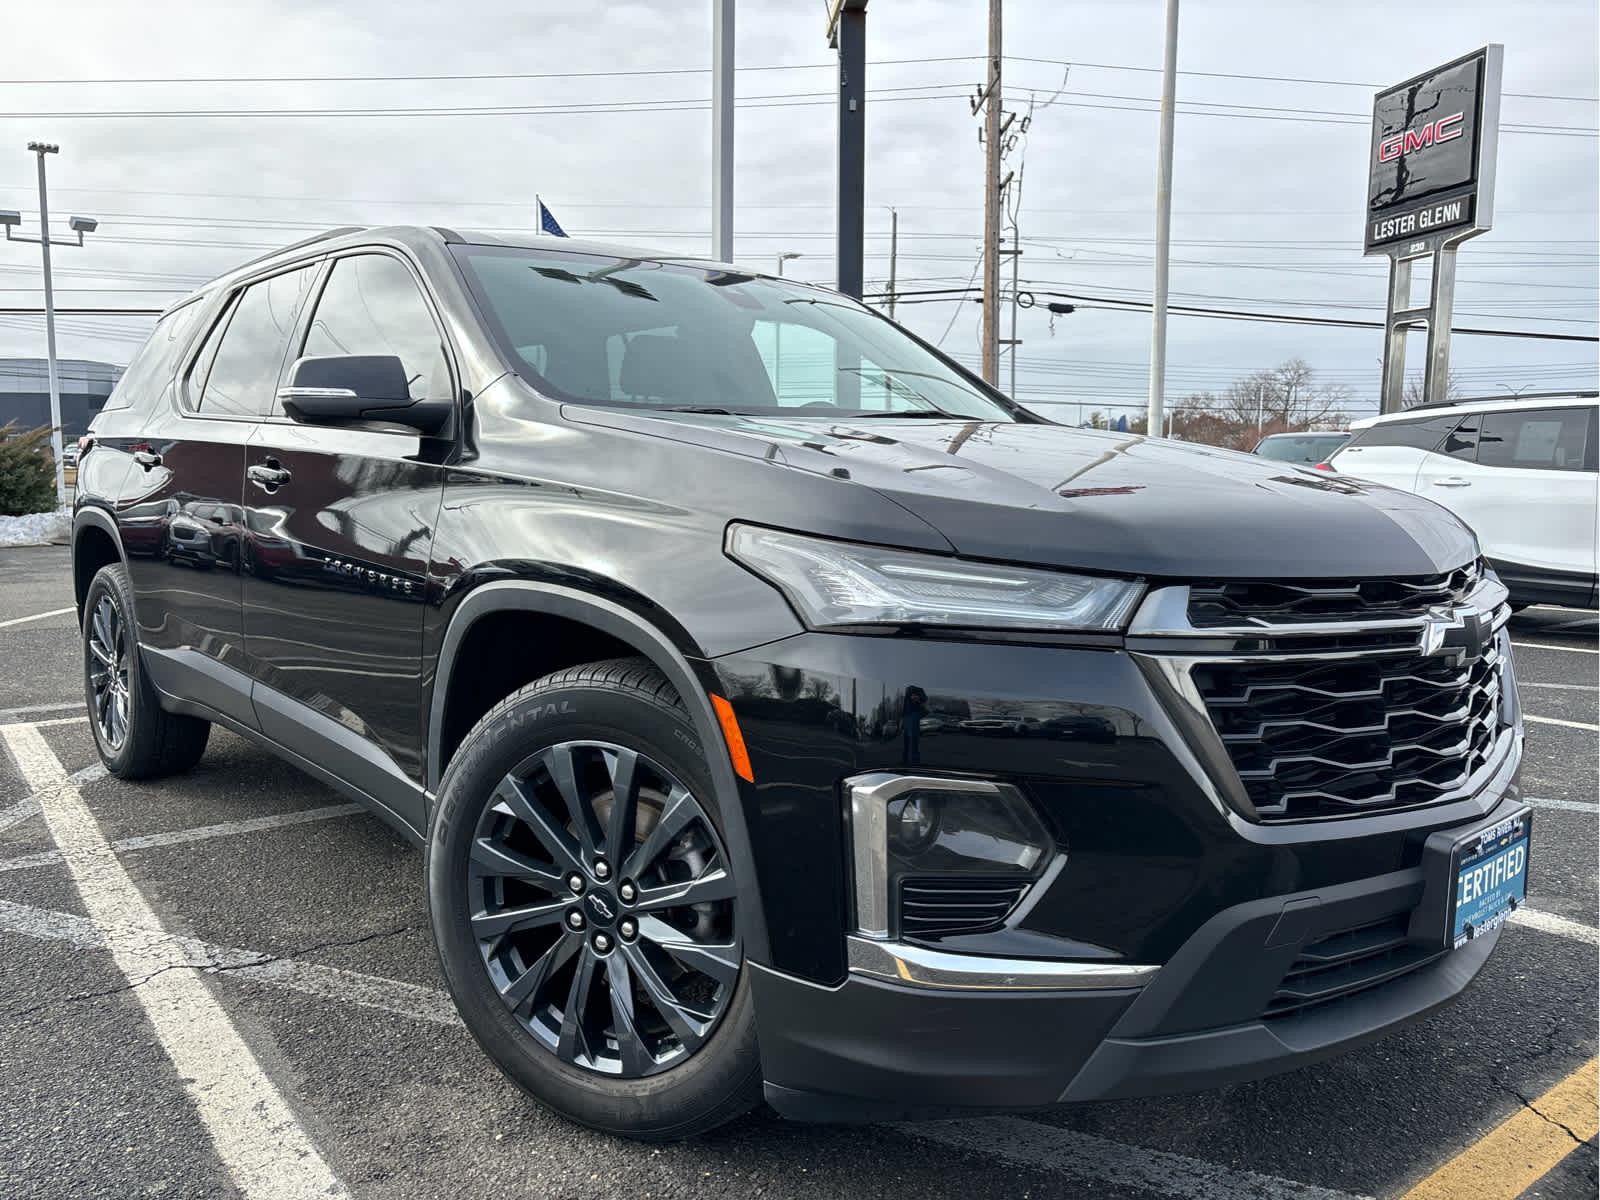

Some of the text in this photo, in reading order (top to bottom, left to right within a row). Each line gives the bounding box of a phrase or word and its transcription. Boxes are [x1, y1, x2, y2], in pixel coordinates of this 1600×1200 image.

[1379, 112, 1464, 163] GMC
[1374, 202, 1461, 240] LESTER GLENN
